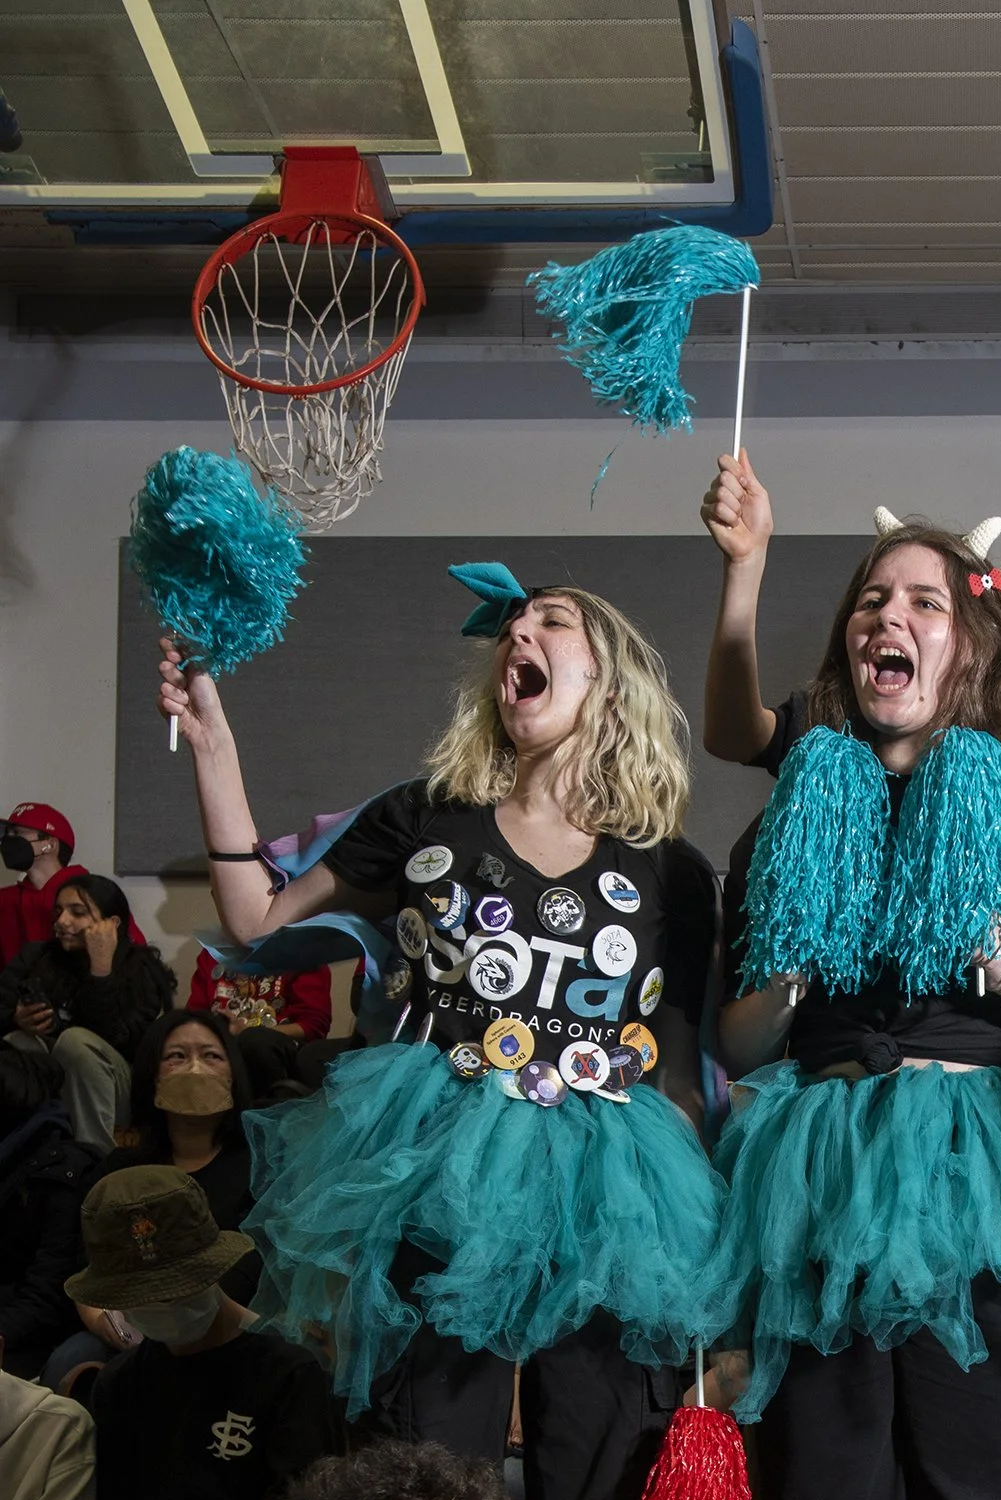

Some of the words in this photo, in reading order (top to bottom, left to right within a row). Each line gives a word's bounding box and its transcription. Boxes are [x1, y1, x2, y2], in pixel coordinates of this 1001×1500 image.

[601, 929, 622, 945] SOTA
[427, 987, 616, 1043] YBERDRAGONS
[509, 1052, 527, 1066] 9143
